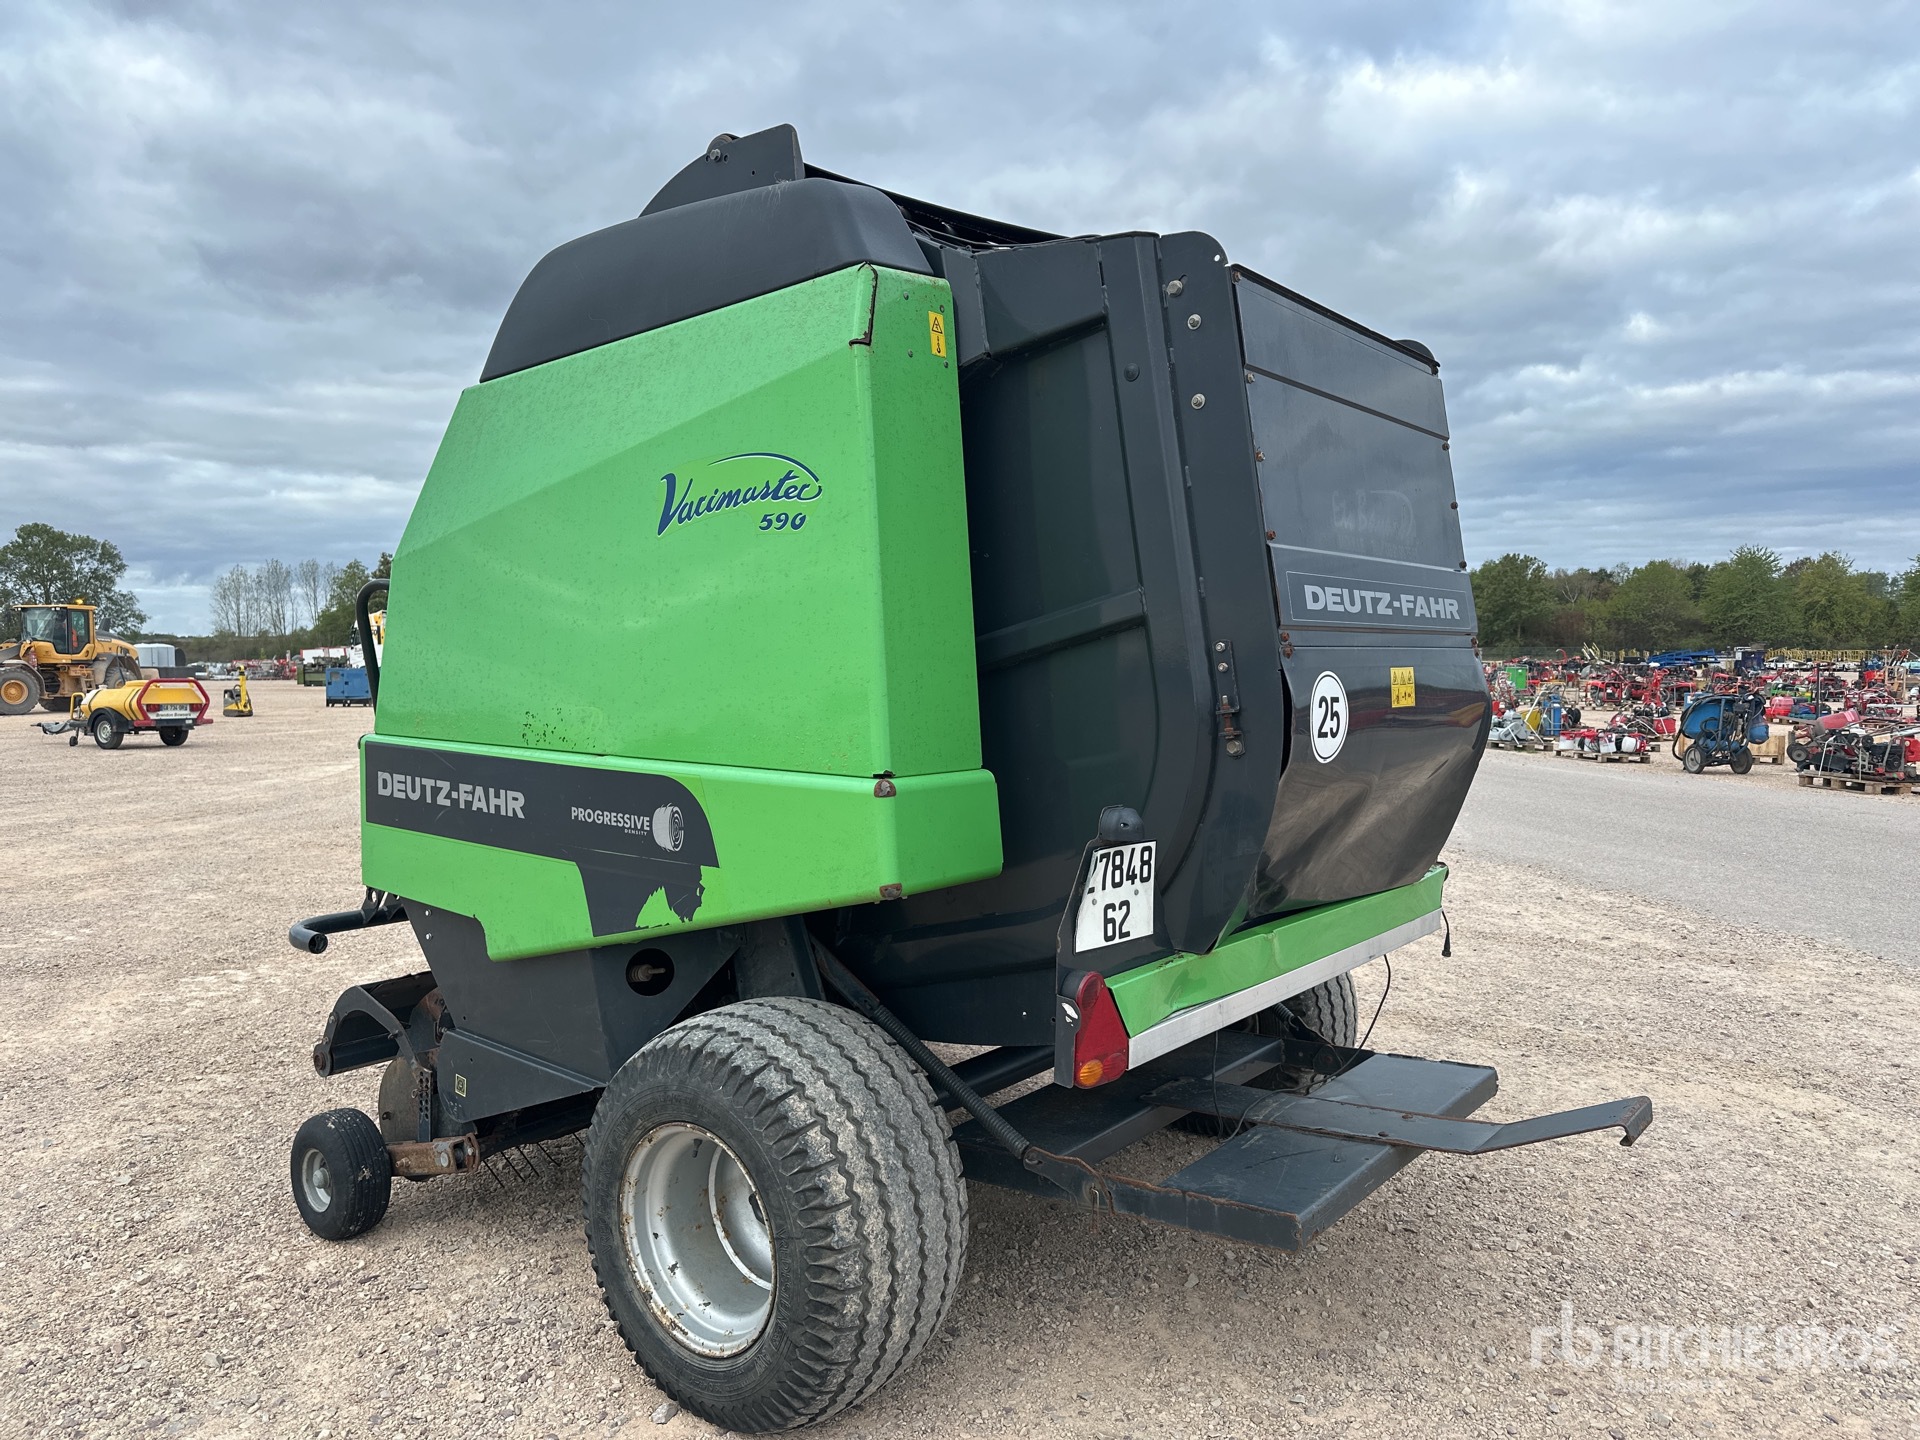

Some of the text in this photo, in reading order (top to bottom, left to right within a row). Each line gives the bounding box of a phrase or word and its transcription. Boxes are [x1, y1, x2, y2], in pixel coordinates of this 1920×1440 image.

[759, 512, 806, 531] 590
[1304, 585, 1460, 620] DEUTZ-FAHR
[1317, 695, 1341, 739] 25
[377, 771, 525, 819] DEUTZ-FAHR
[571, 806, 650, 831] PROGRESSIVE
[624, 828, 648, 836] DENSITY
[1103, 900, 1131, 942] 62
